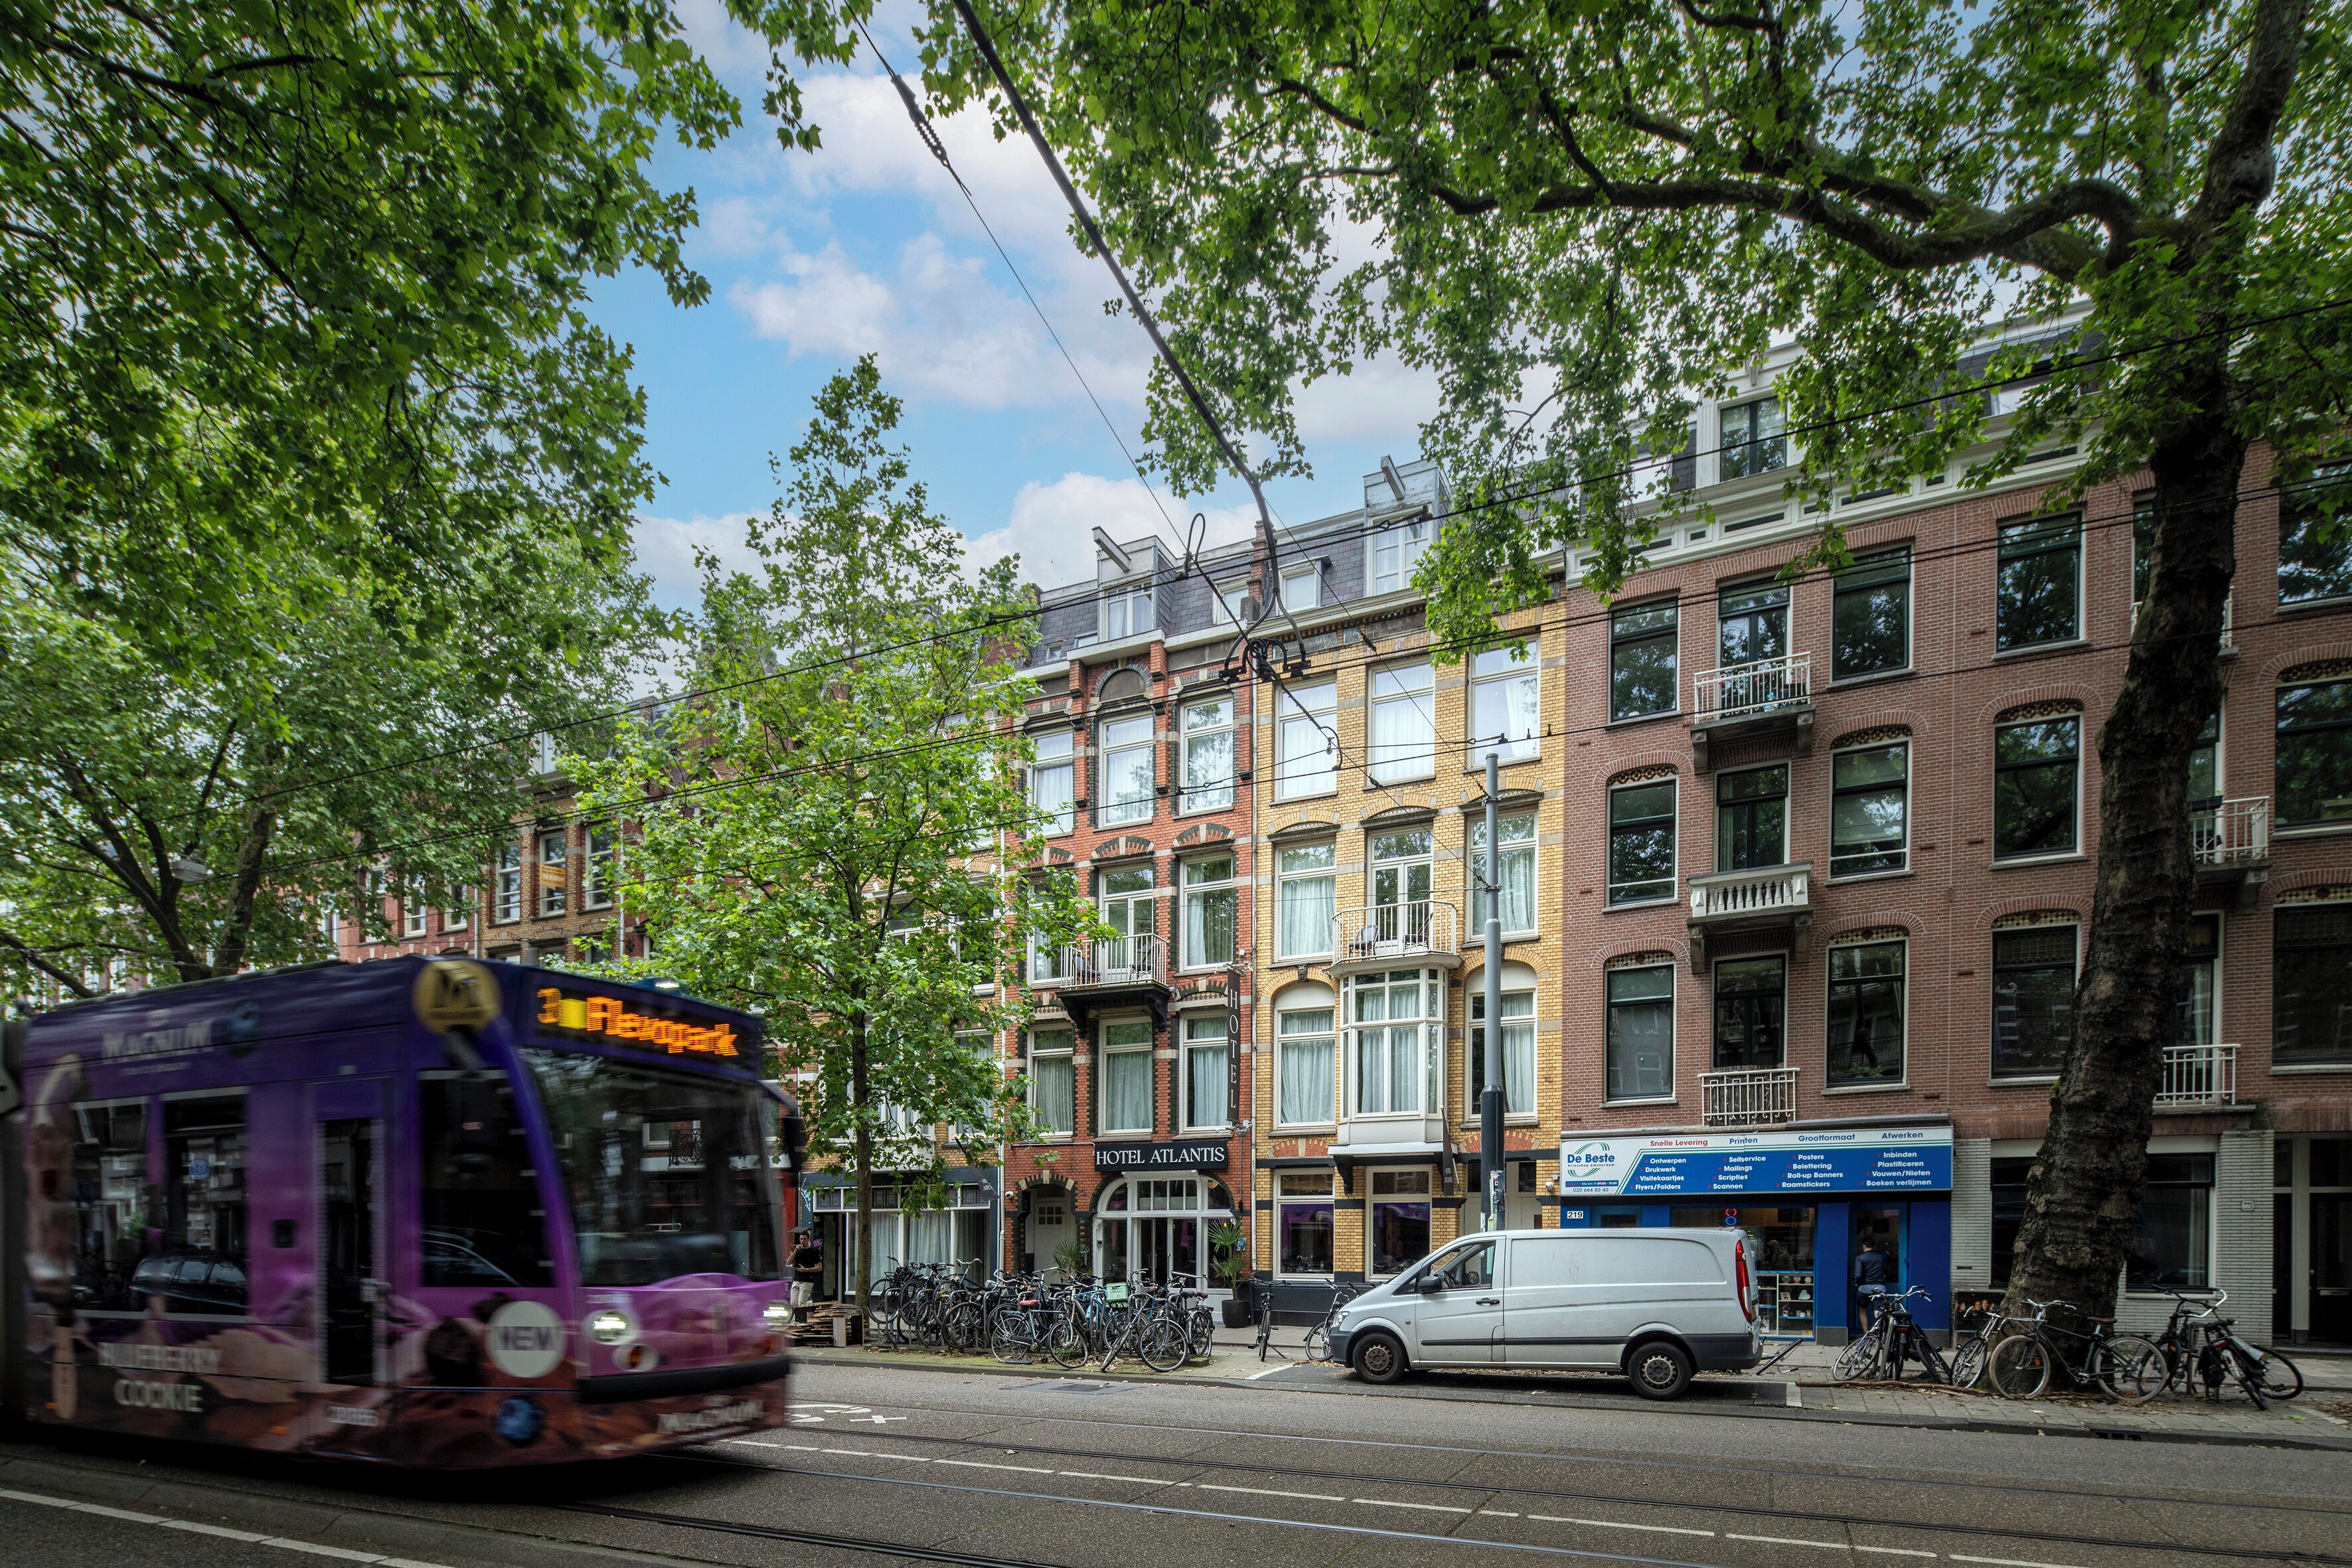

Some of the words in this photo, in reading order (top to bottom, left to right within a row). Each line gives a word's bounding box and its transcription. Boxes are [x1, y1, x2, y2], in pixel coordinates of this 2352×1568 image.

[536, 987, 562, 1024] 3
[1229, 989, 1239, 1109] HOTEL
[1096, 1150, 1145, 1165] HOTEL
[1150, 1147, 1225, 1163] ATLANTIS
[1567, 1154, 1582, 1163] De
[1585, 1153, 1615, 1163] Beste
[494, 1326, 556, 1351] NEW
[114, 1378, 203, 1413] COOKIE
